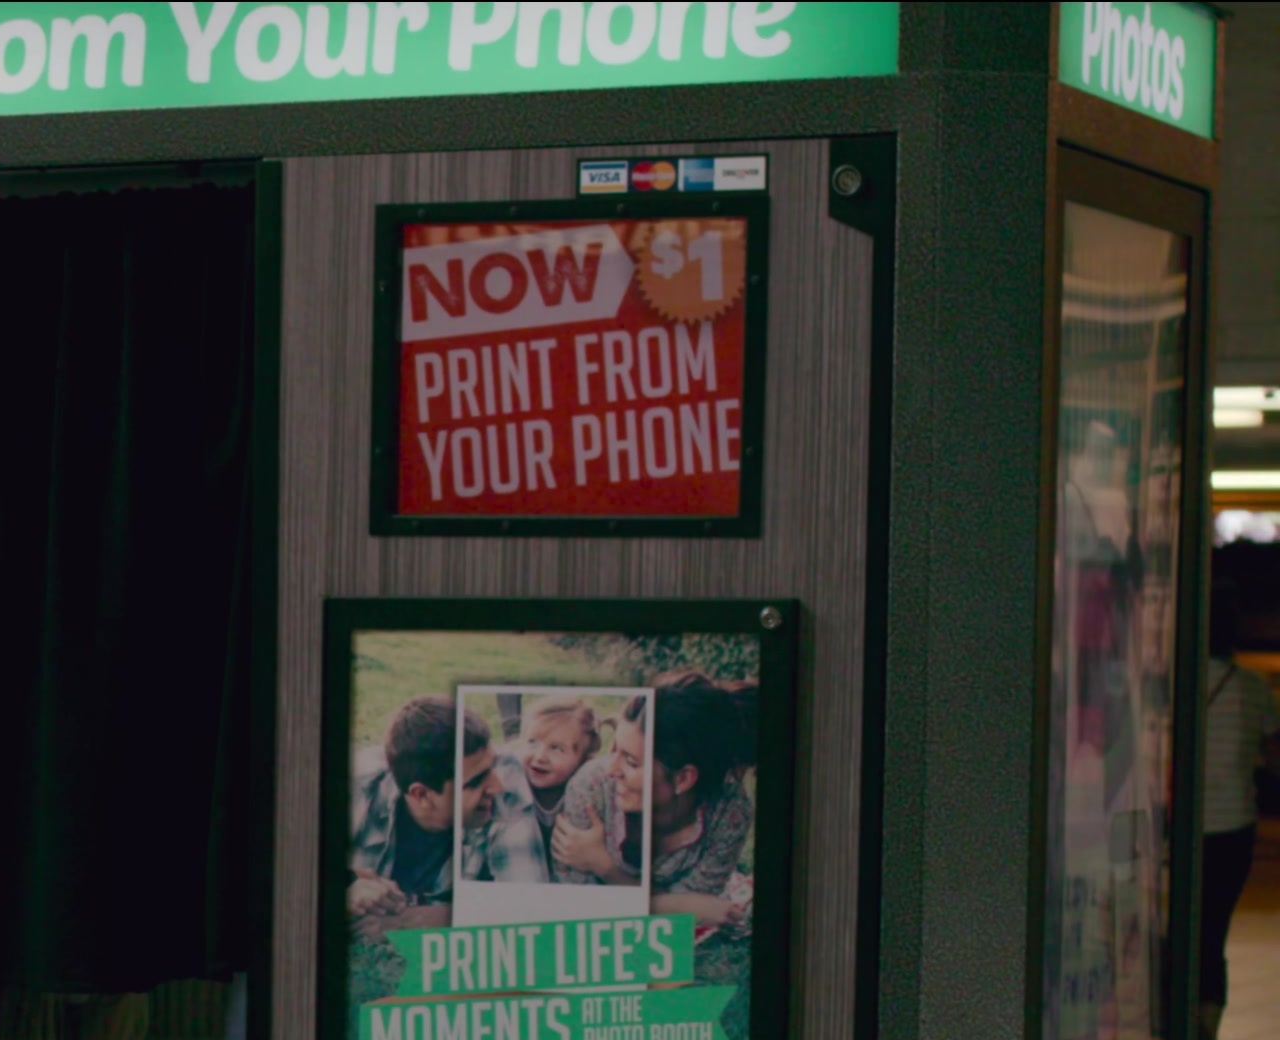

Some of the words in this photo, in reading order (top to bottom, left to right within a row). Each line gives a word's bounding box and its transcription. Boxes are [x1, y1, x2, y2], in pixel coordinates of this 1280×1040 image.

[169, 2, 430, 84] Your
[447, 2, 793, 72] Phone
[1082, 2, 1186, 120] Photos
[589, 172, 621, 183] VISA
[407, 242, 604, 323] NOW
[650, 229, 724, 301] $1
[414, 338, 558, 424] PRINT
[575, 321, 718, 405] FROM
[418, 419, 557, 501] YOUR
[571, 398, 740, 486] PHONE
[421, 926, 541, 993] PRINT
[555, 918, 674, 985] LIFE'S
[582, 997, 603, 1025] AT
[610, 995, 643, 1023] THE
